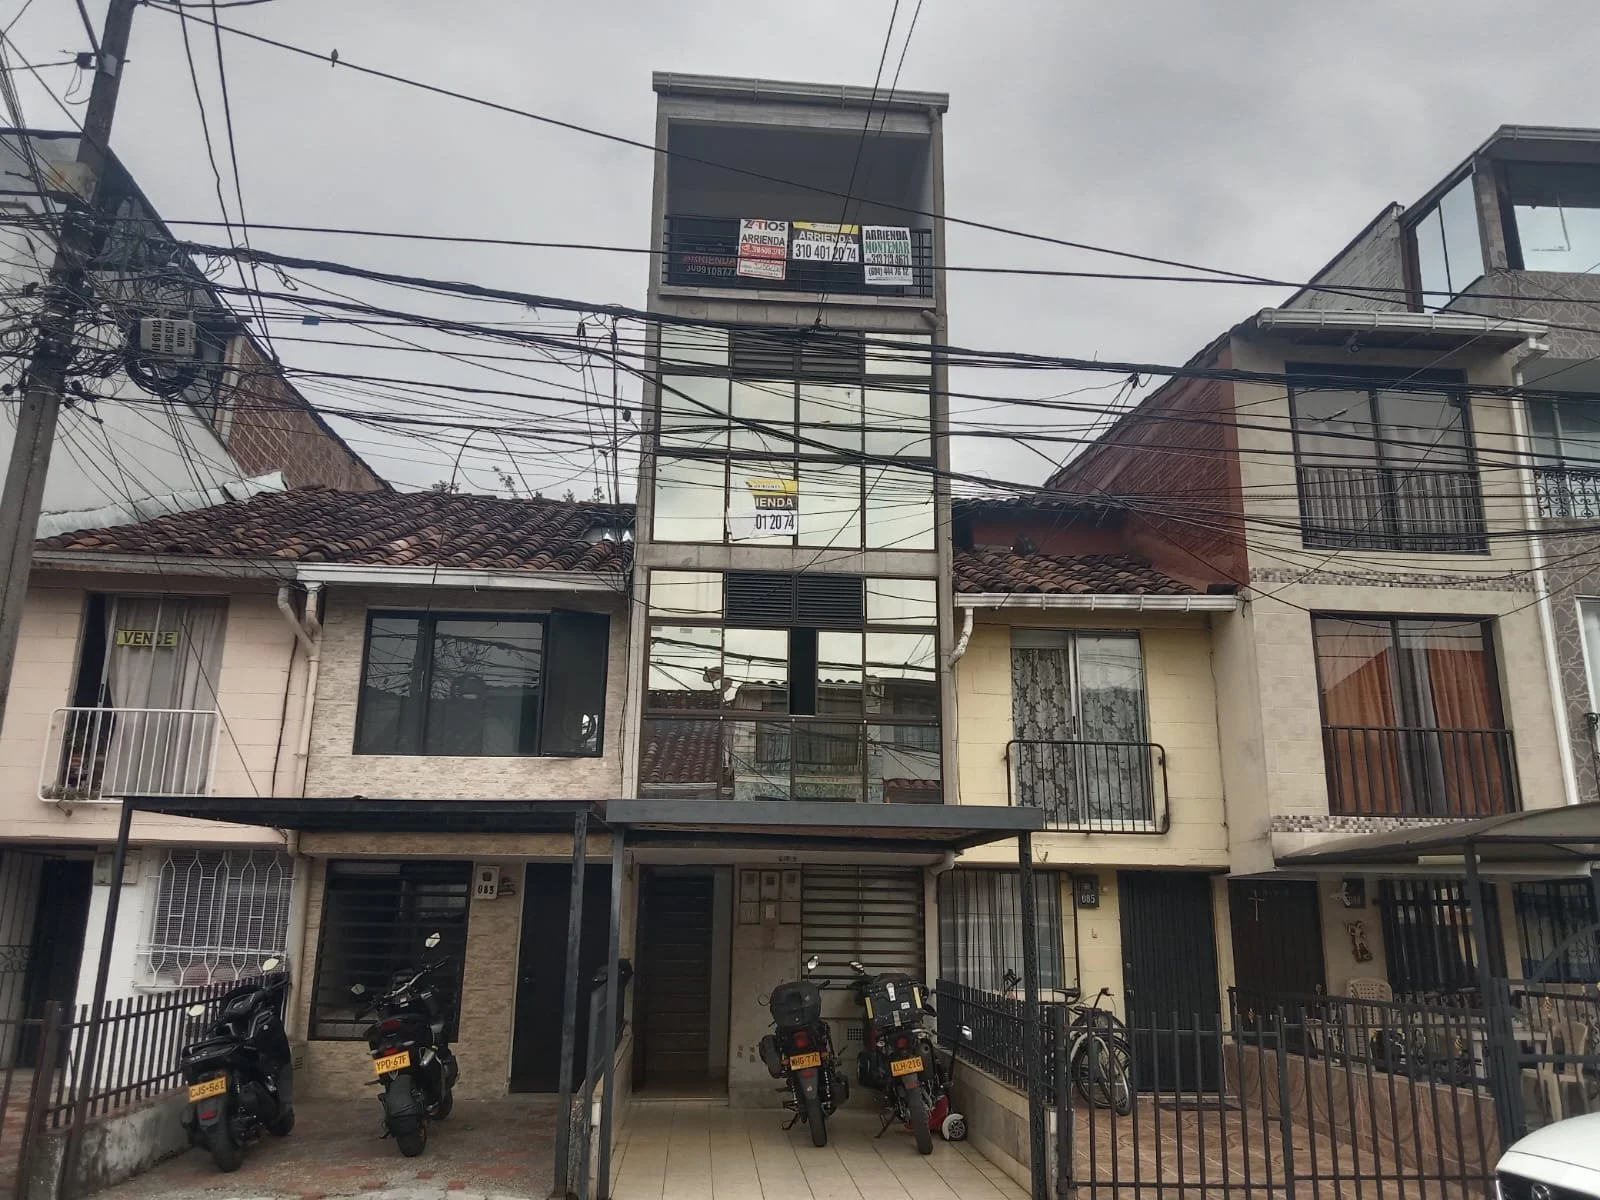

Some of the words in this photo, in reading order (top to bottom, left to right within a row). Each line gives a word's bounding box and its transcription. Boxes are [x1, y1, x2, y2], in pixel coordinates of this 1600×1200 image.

[741, 234, 785, 246] ARRIENDA
[799, 231, 854, 244] ARRIENDA
[865, 230, 909, 240] ARRIENDA
[795, 244, 811, 258] 310
[814, 245, 830, 259] 401
[833, 246, 844, 260] 20
[846, 247, 857, 262] 74
[865, 241, 909, 254] MONTEMAR
[756, 514, 766, 529] 01
[769, 514, 781, 529] 20
[783, 514, 794, 530] 74
